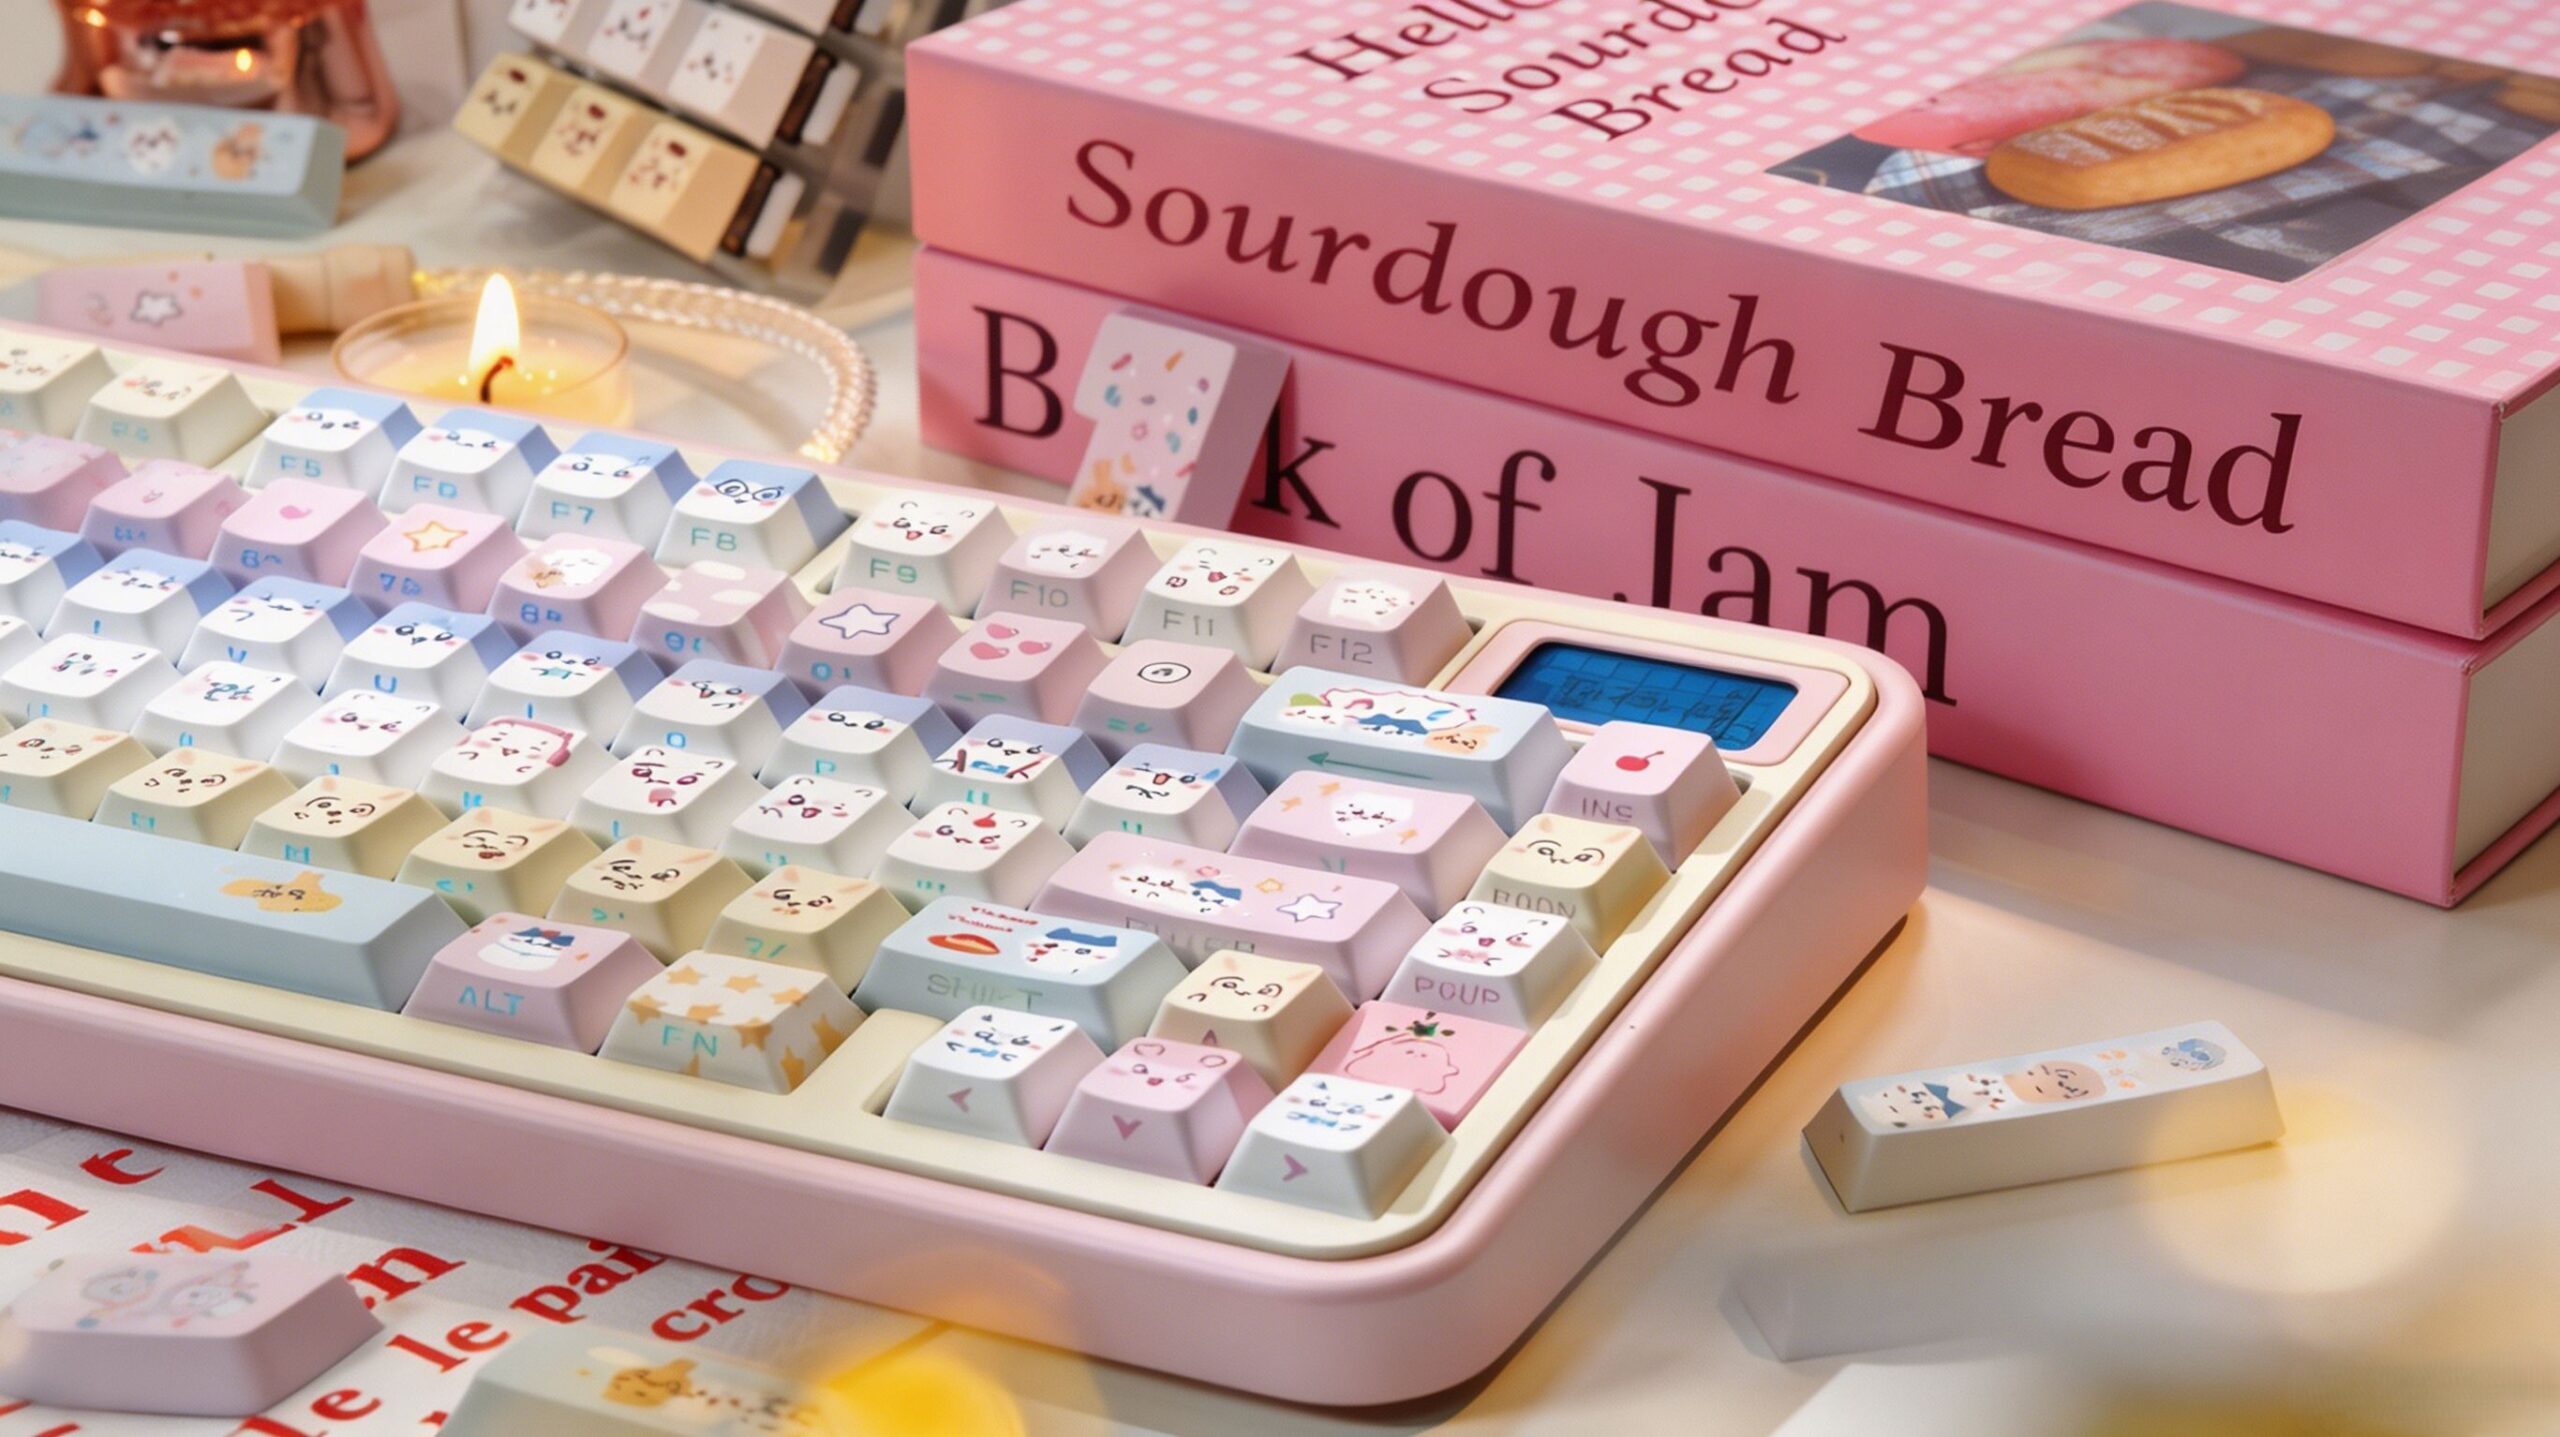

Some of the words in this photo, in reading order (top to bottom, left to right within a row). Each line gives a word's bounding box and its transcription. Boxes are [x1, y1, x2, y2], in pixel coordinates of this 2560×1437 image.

[1290, 0, 1556, 82] Hell
[1551, 16, 1847, 142] Bread
[1066, 139, 1800, 408] Sourdough
[1858, 341, 2303, 536] Bread
[551, 502, 595, 524] F7
[972, 306, 1341, 529] Bk
[1392, 450, 1556, 586] of
[1613, 476, 1957, 707] Jam
[870, 558, 918, 583] F9
[1010, 579, 1069, 610] F10
[1162, 609, 1215, 637] F11
[1310, 633, 1373, 665] F12
[459, 986, 525, 1017] ALT
[662, 1024, 718, 1057] FN
[386, 1320, 511, 1374] le
